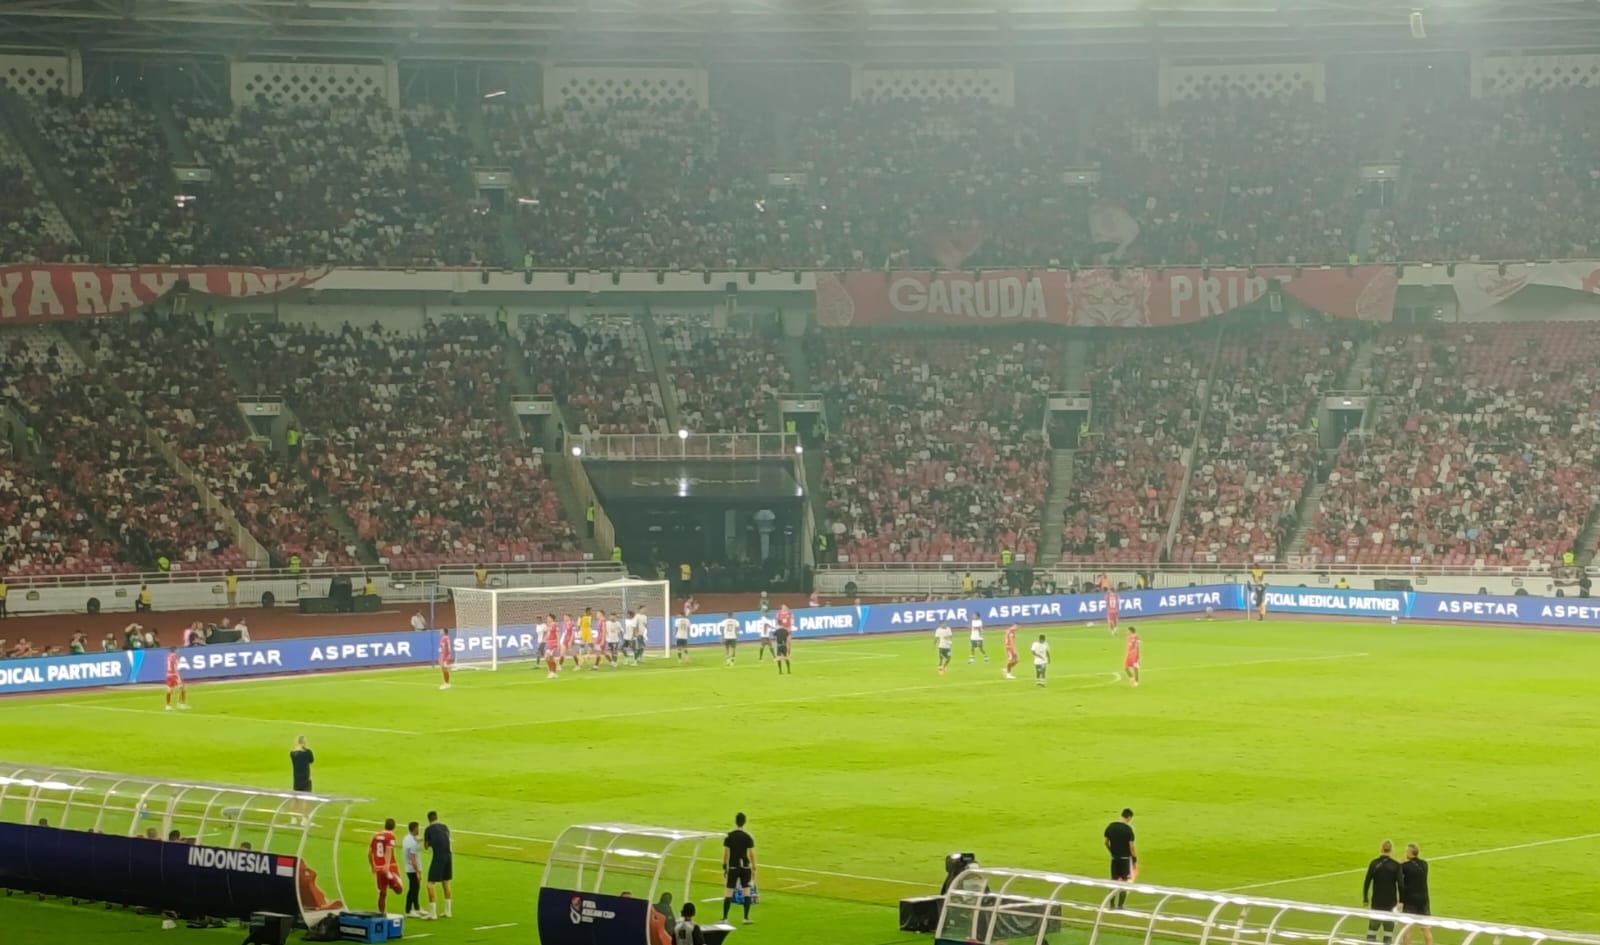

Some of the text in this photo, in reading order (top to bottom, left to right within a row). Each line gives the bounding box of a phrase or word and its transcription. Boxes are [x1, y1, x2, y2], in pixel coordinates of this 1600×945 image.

[889, 275, 1291, 318] GARUDA PRID
[1079, 597, 1142, 613] ASPTAR
[1159, 592, 1222, 607] ASPETAR
[1299, 594, 1346, 609] MEDICAL
[1349, 597, 1400, 611] PARTNER
[891, 608, 969, 624] ASPETAR
[988, 603, 1062, 618] ASPETAR
[1438, 601, 1519, 618] ASPETAR
[800, 615, 853, 630] PARTNER
[309, 641, 412, 661] ASPETAR
[177, 650, 282, 670] ASPETAR
[48, 661, 122, 682] PARTNER
[376, 842, 384, 857] 8
[188, 847, 271, 875] INDONESIA
